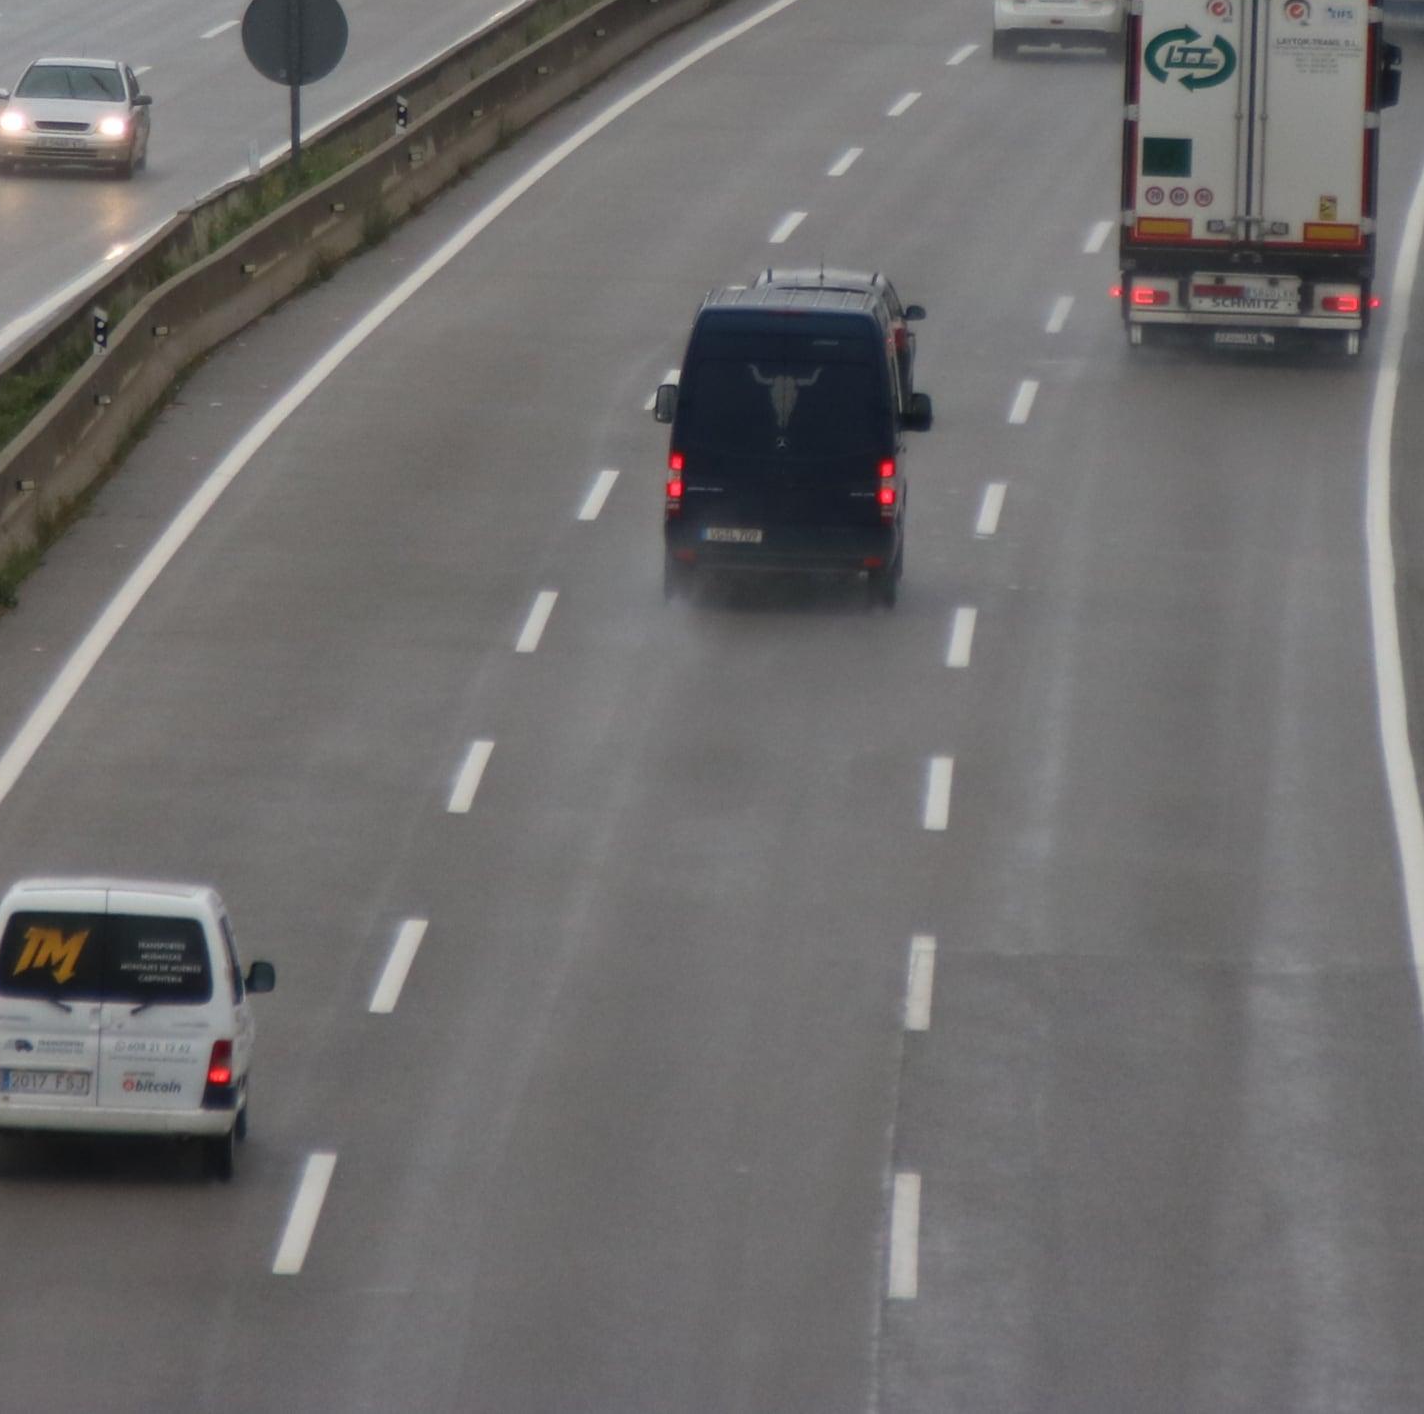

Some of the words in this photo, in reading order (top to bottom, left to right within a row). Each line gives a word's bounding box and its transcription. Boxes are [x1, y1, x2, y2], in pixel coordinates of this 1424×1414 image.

[1212, 297, 1279, 310] SCHMITZ
[10, 1072, 48, 1089] 2017
[135, 1080, 182, 1094] bitcoin
